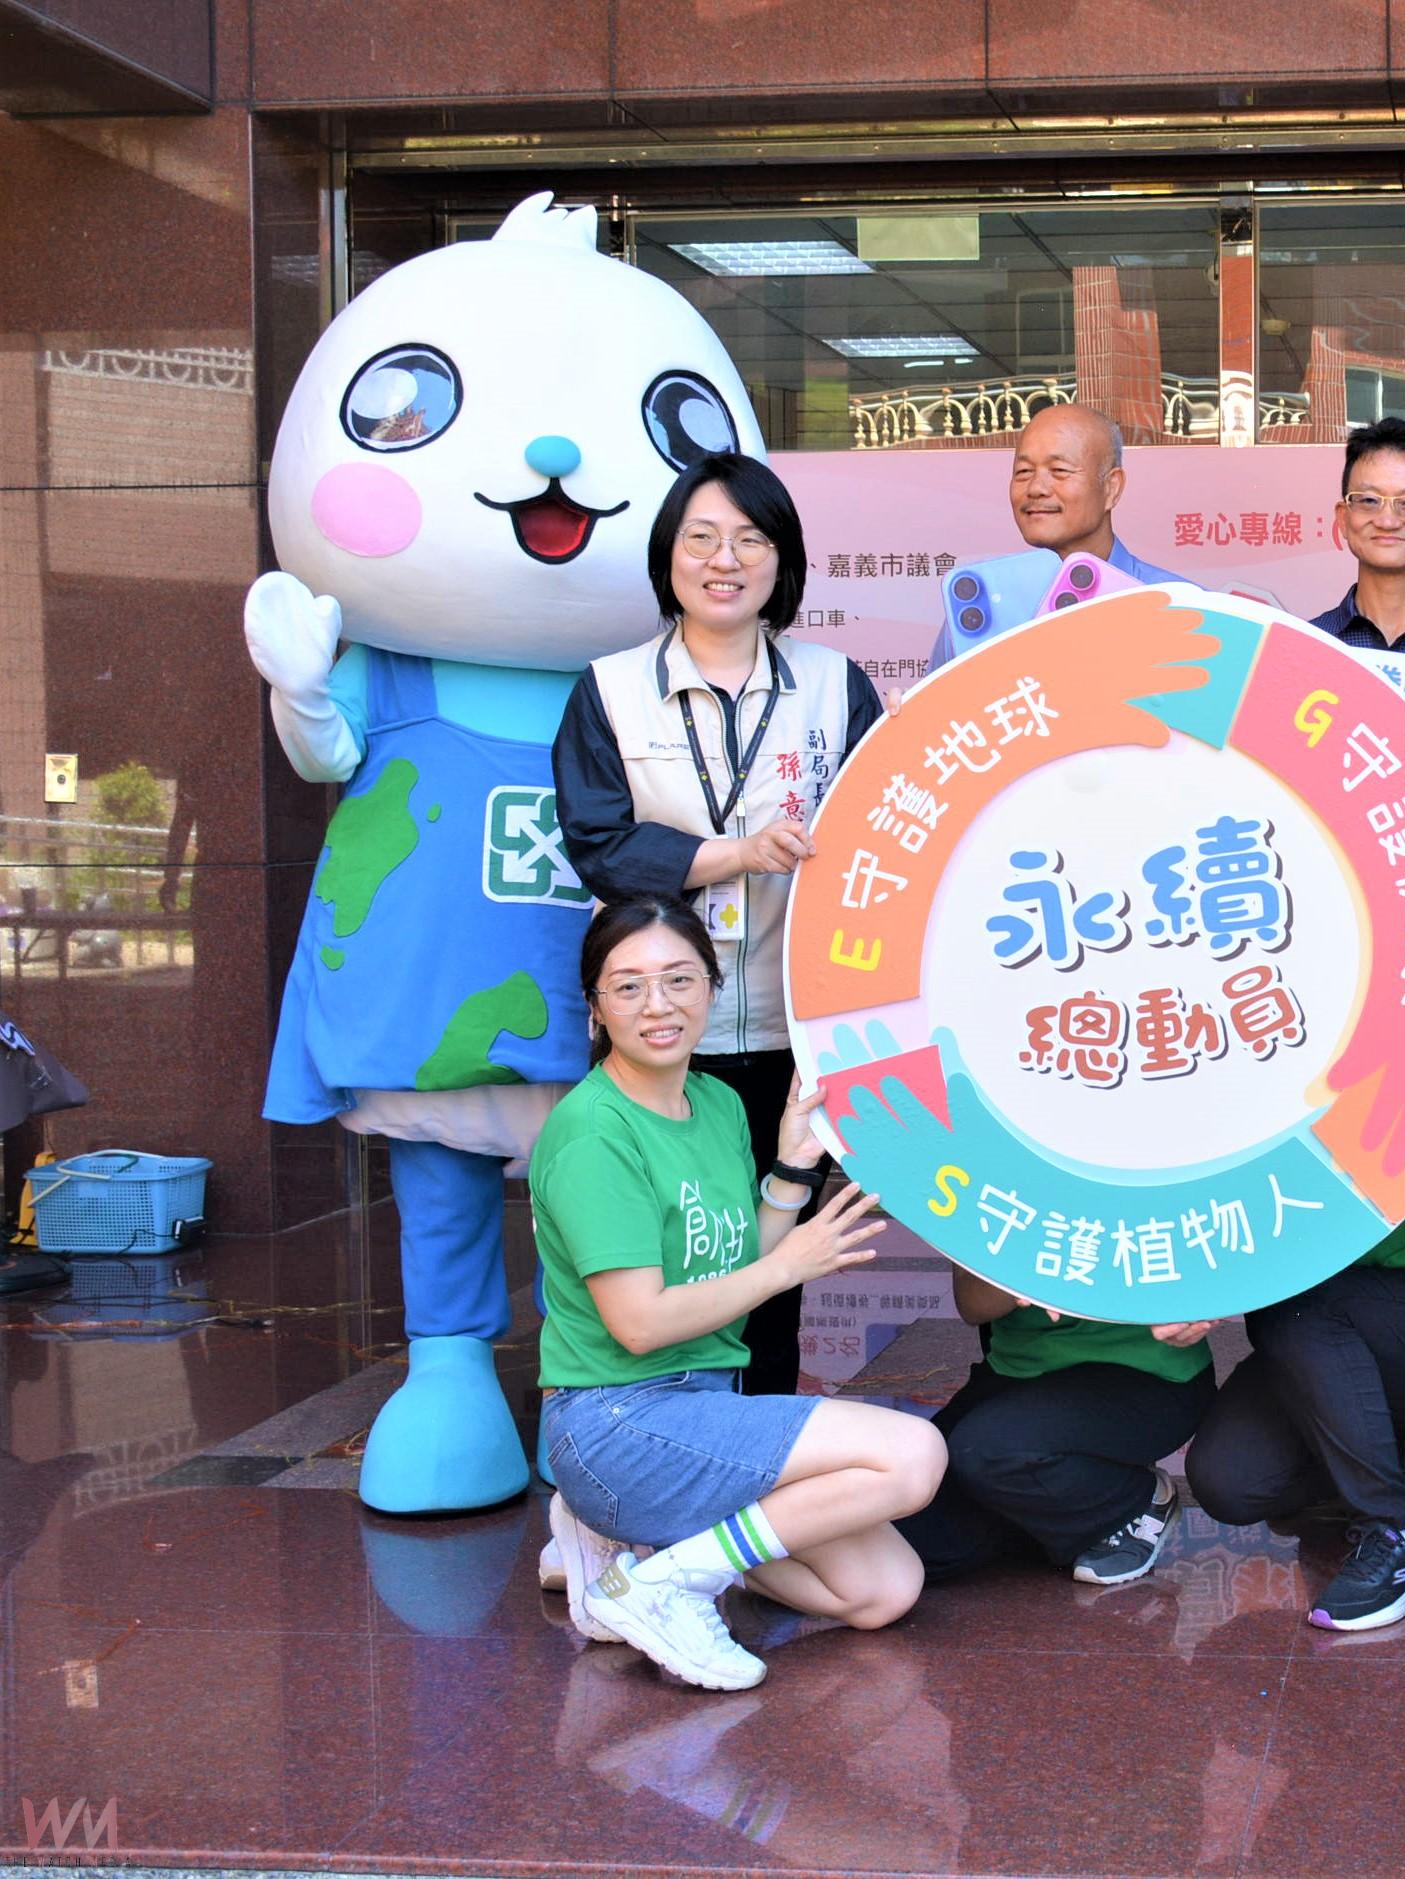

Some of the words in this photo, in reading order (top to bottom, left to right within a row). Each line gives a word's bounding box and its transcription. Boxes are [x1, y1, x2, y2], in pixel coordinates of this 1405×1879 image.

[840, 676, 1060, 911] 守護地球
[985, 815, 1291, 965] 永續
[1018, 964, 1304, 1084] 總動員
[977, 1174, 1325, 1288] 守護植物人
